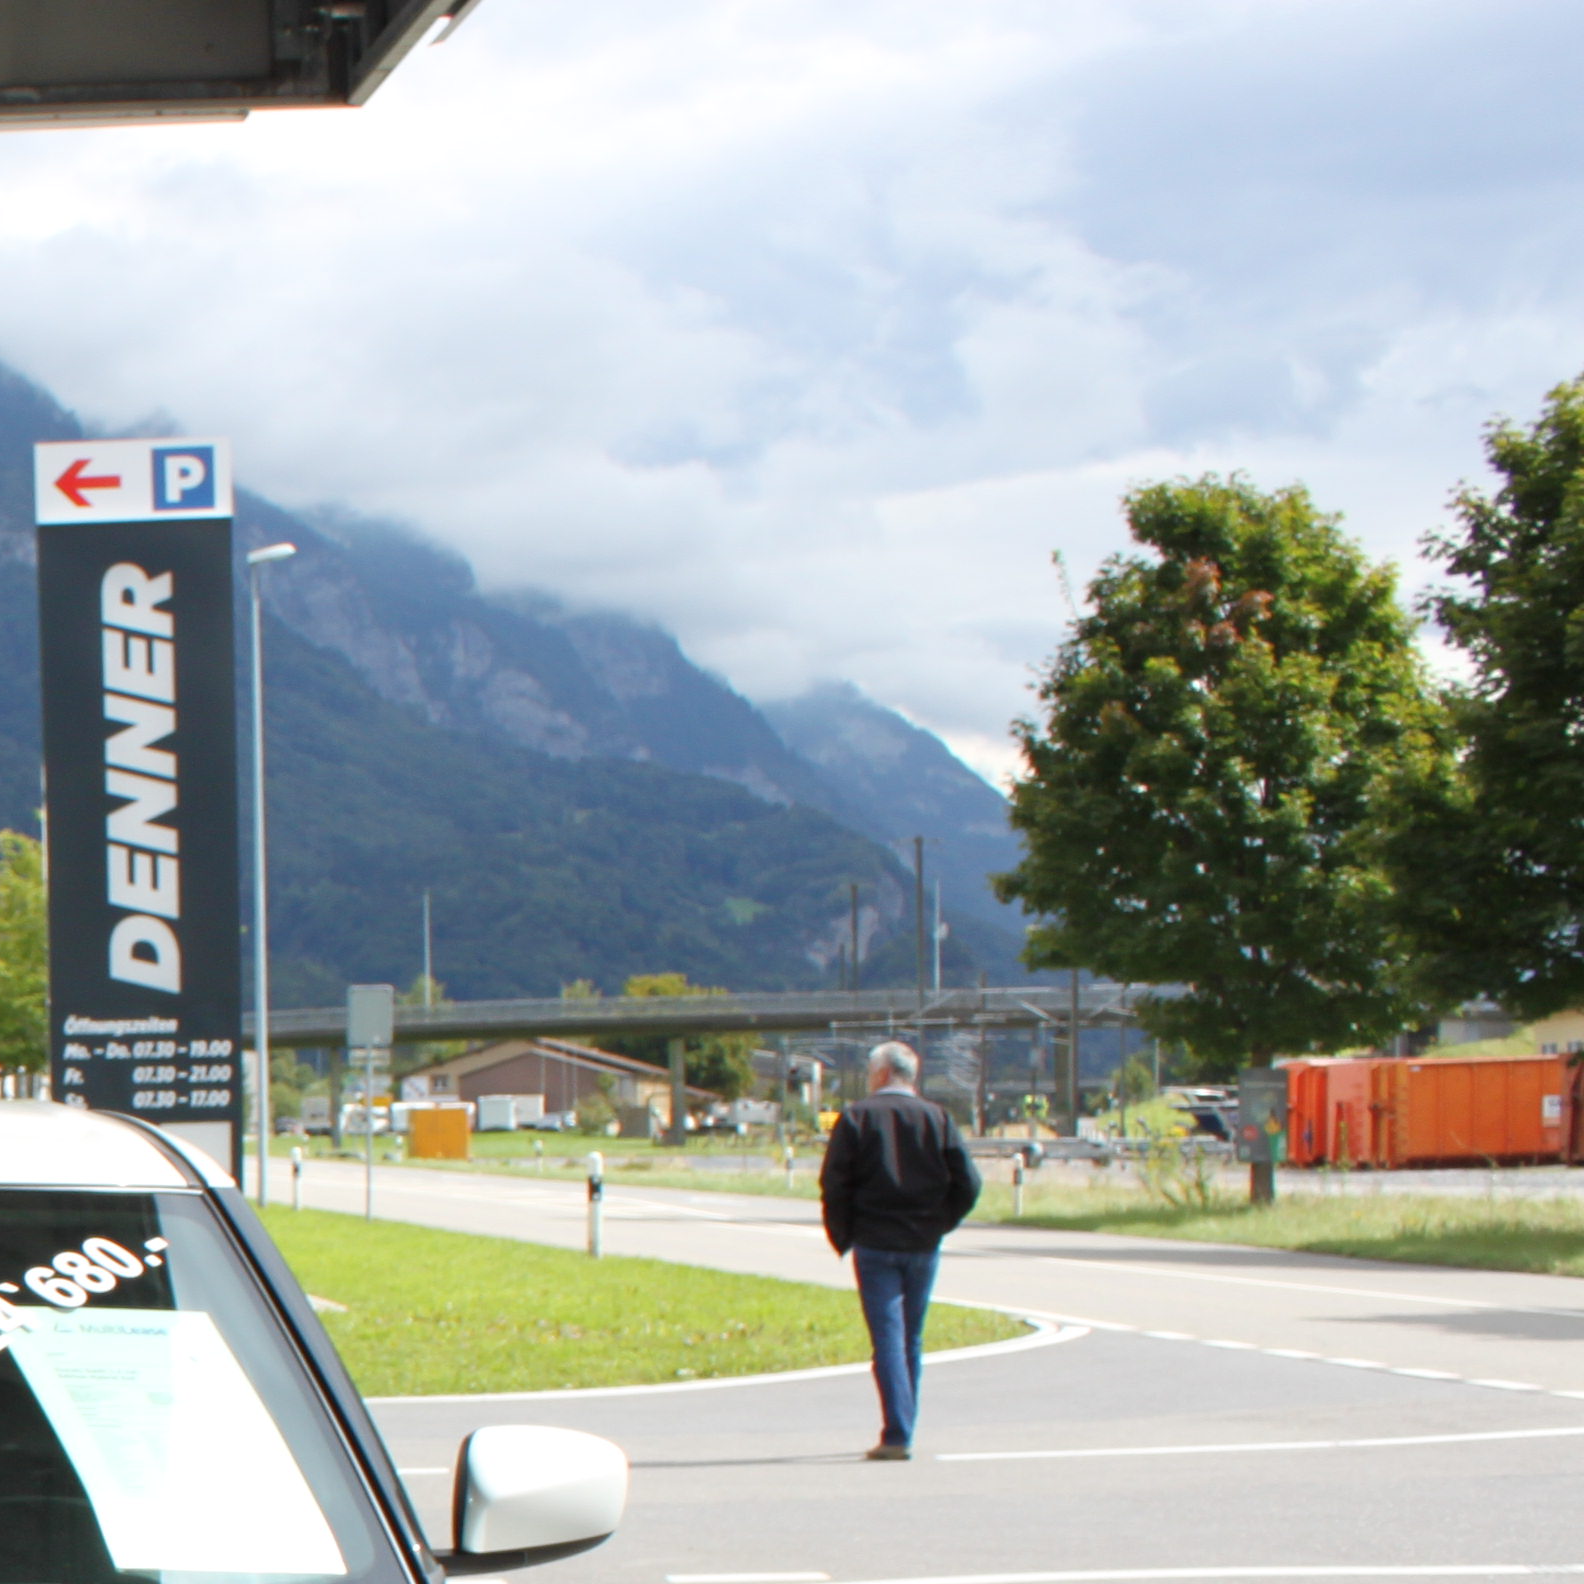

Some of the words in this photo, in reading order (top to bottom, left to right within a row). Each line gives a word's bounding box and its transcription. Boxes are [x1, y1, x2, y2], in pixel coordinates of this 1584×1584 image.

[163, 454, 206, 503] P
[100, 560, 182, 994] DENNER
[63, 1014, 178, 1037] Öffnungszeiten
[133, 1040, 177, 1059] 07.30
[63, 1067, 84, 1085] Fr.
[133, 1065, 177, 1084] 07.30
